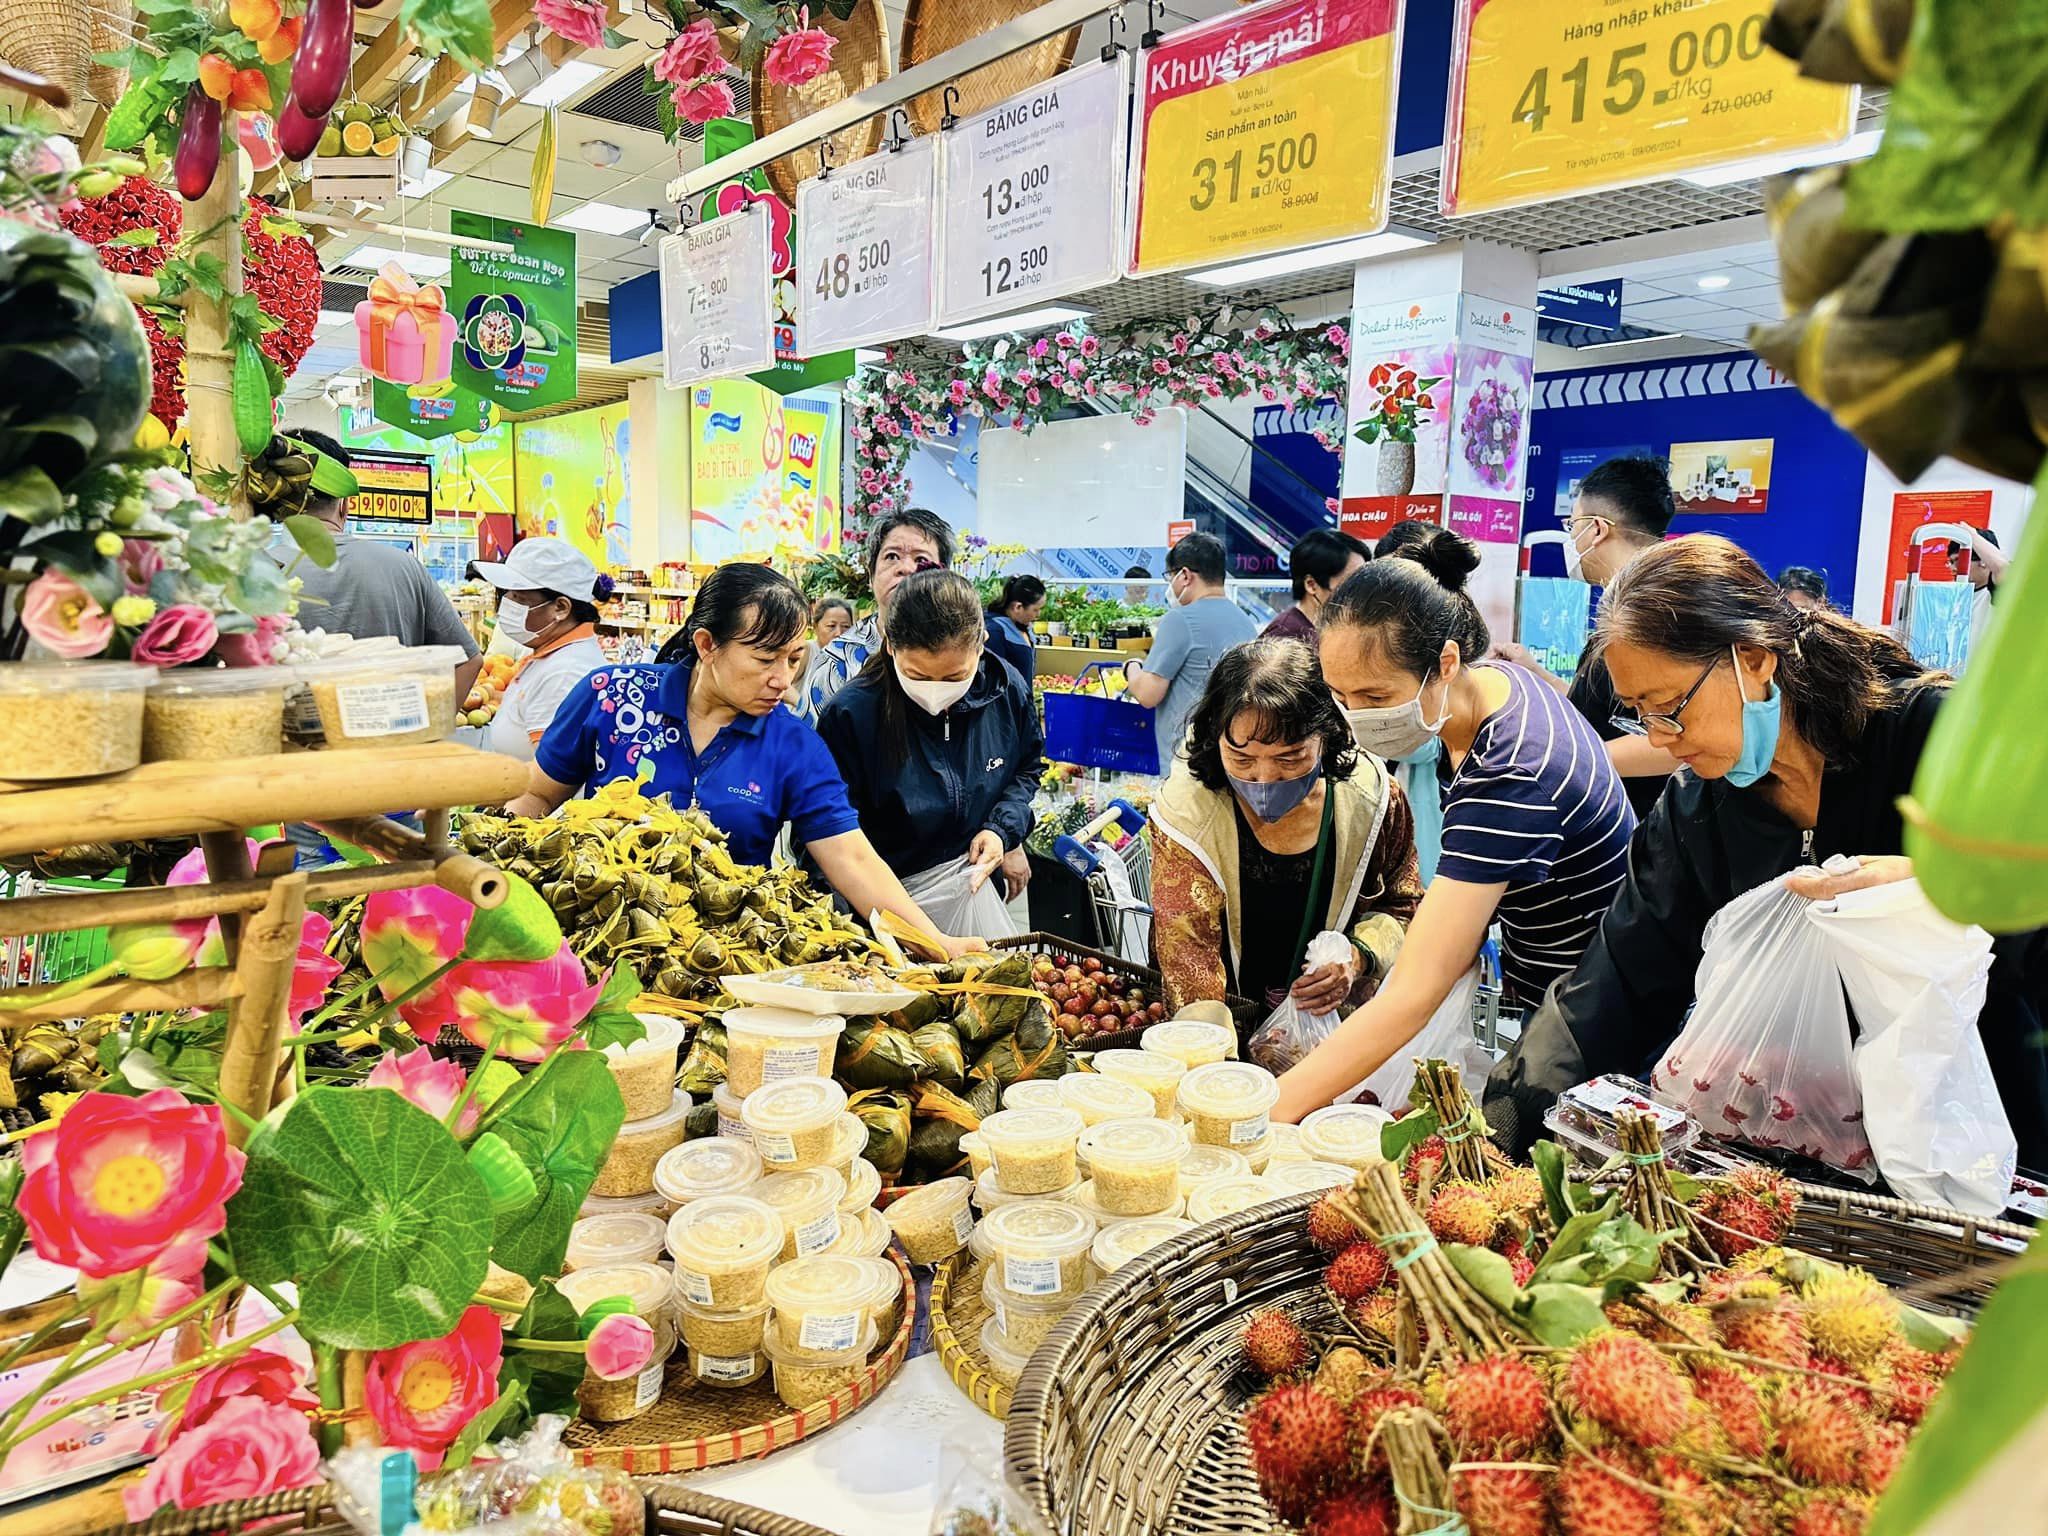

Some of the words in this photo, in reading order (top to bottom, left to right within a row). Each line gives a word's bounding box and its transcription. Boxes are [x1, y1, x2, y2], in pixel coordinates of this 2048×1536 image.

[1564, 21, 1603, 42] Hàng
[1608, 9, 1648, 30] nhập
[1151, 32, 1255, 94] Khuyến
[1269, 9, 1325, 58] mãi
[1668, 77, 1712, 100] đ/kg
[986, 104, 1028, 139] BẢNG
[1032, 87, 1060, 118] GIÁ
[1206, 128, 1224, 142] Sản
[1227, 119, 1255, 139] phẩm
[1258, 117, 1270, 129] an
[1274, 109, 1297, 125] toàn
[865, 162, 887, 189] GIÁ
[1262, 178, 1291, 195] đ/kg
[1360, 317, 1391, 336] Dalat
[1342, 512, 1360, 522] HOA
[1362, 510, 1387, 523] CHẬU
[1452, 511, 1467, 521] HOA
[1469, 510, 1482, 522] GÓI
